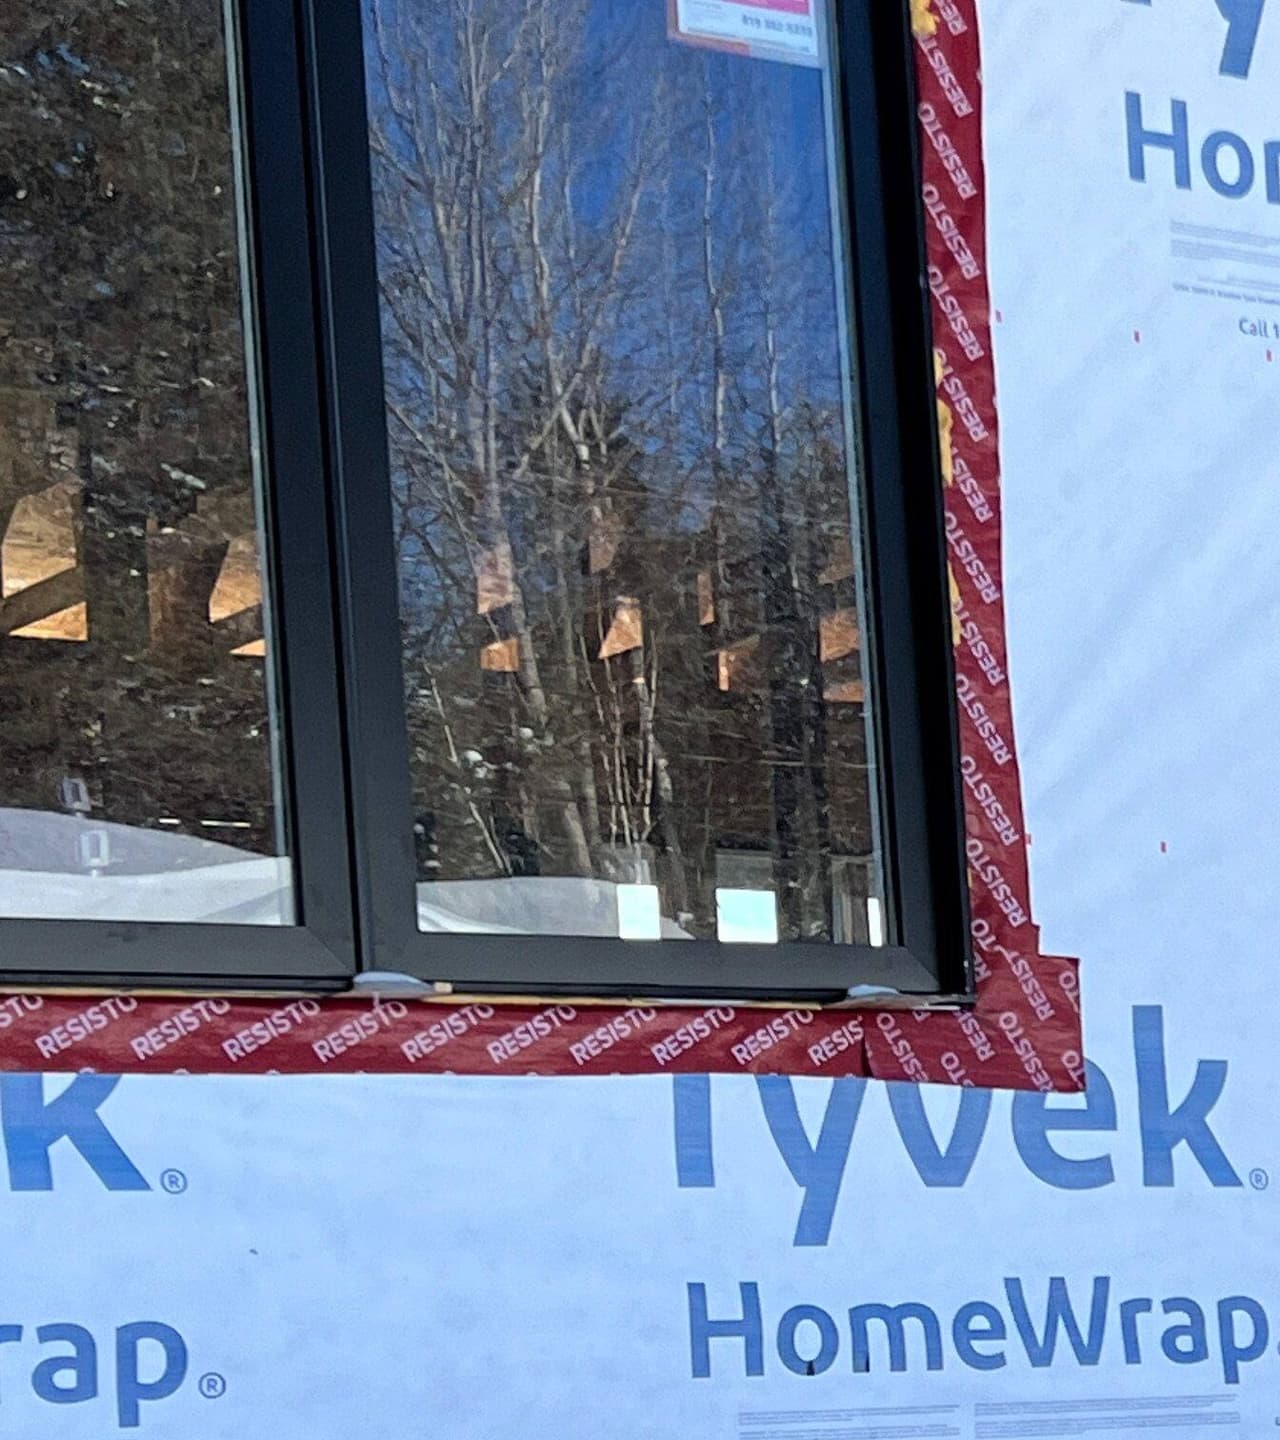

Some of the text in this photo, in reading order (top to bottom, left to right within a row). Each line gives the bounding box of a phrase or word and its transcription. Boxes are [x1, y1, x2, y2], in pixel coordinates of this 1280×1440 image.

[918, 38, 973, 117] RESIST
[918, 103, 977, 200] RESISTO
[922, 183, 980, 280] RESISTO
[927, 265, 984, 361] RESISTO
[1239, 318, 1268, 338] Call
[951, 446, 994, 522] RESIS
[956, 673, 1011, 765] RESISTO
[960, 754, 1019, 846] RESISTO
[965, 837, 1028, 928] RESISTO
[35, 995, 138, 1059] RESISTO
[130, 998, 231, 1061] RESISTO
[222, 999, 320, 1062] RESISTO
[312, 1000, 408, 1063] RESISTO
[401, 1002, 494, 1063] RESISTO
[486, 1004, 577, 1064] RESISTO
[569, 1006, 658, 1065] RESISTO
[650, 1006, 736, 1066] RESISTO
[731, 1008, 814, 1067] RESISTO
[807, 1015, 863, 1067] RESIS
